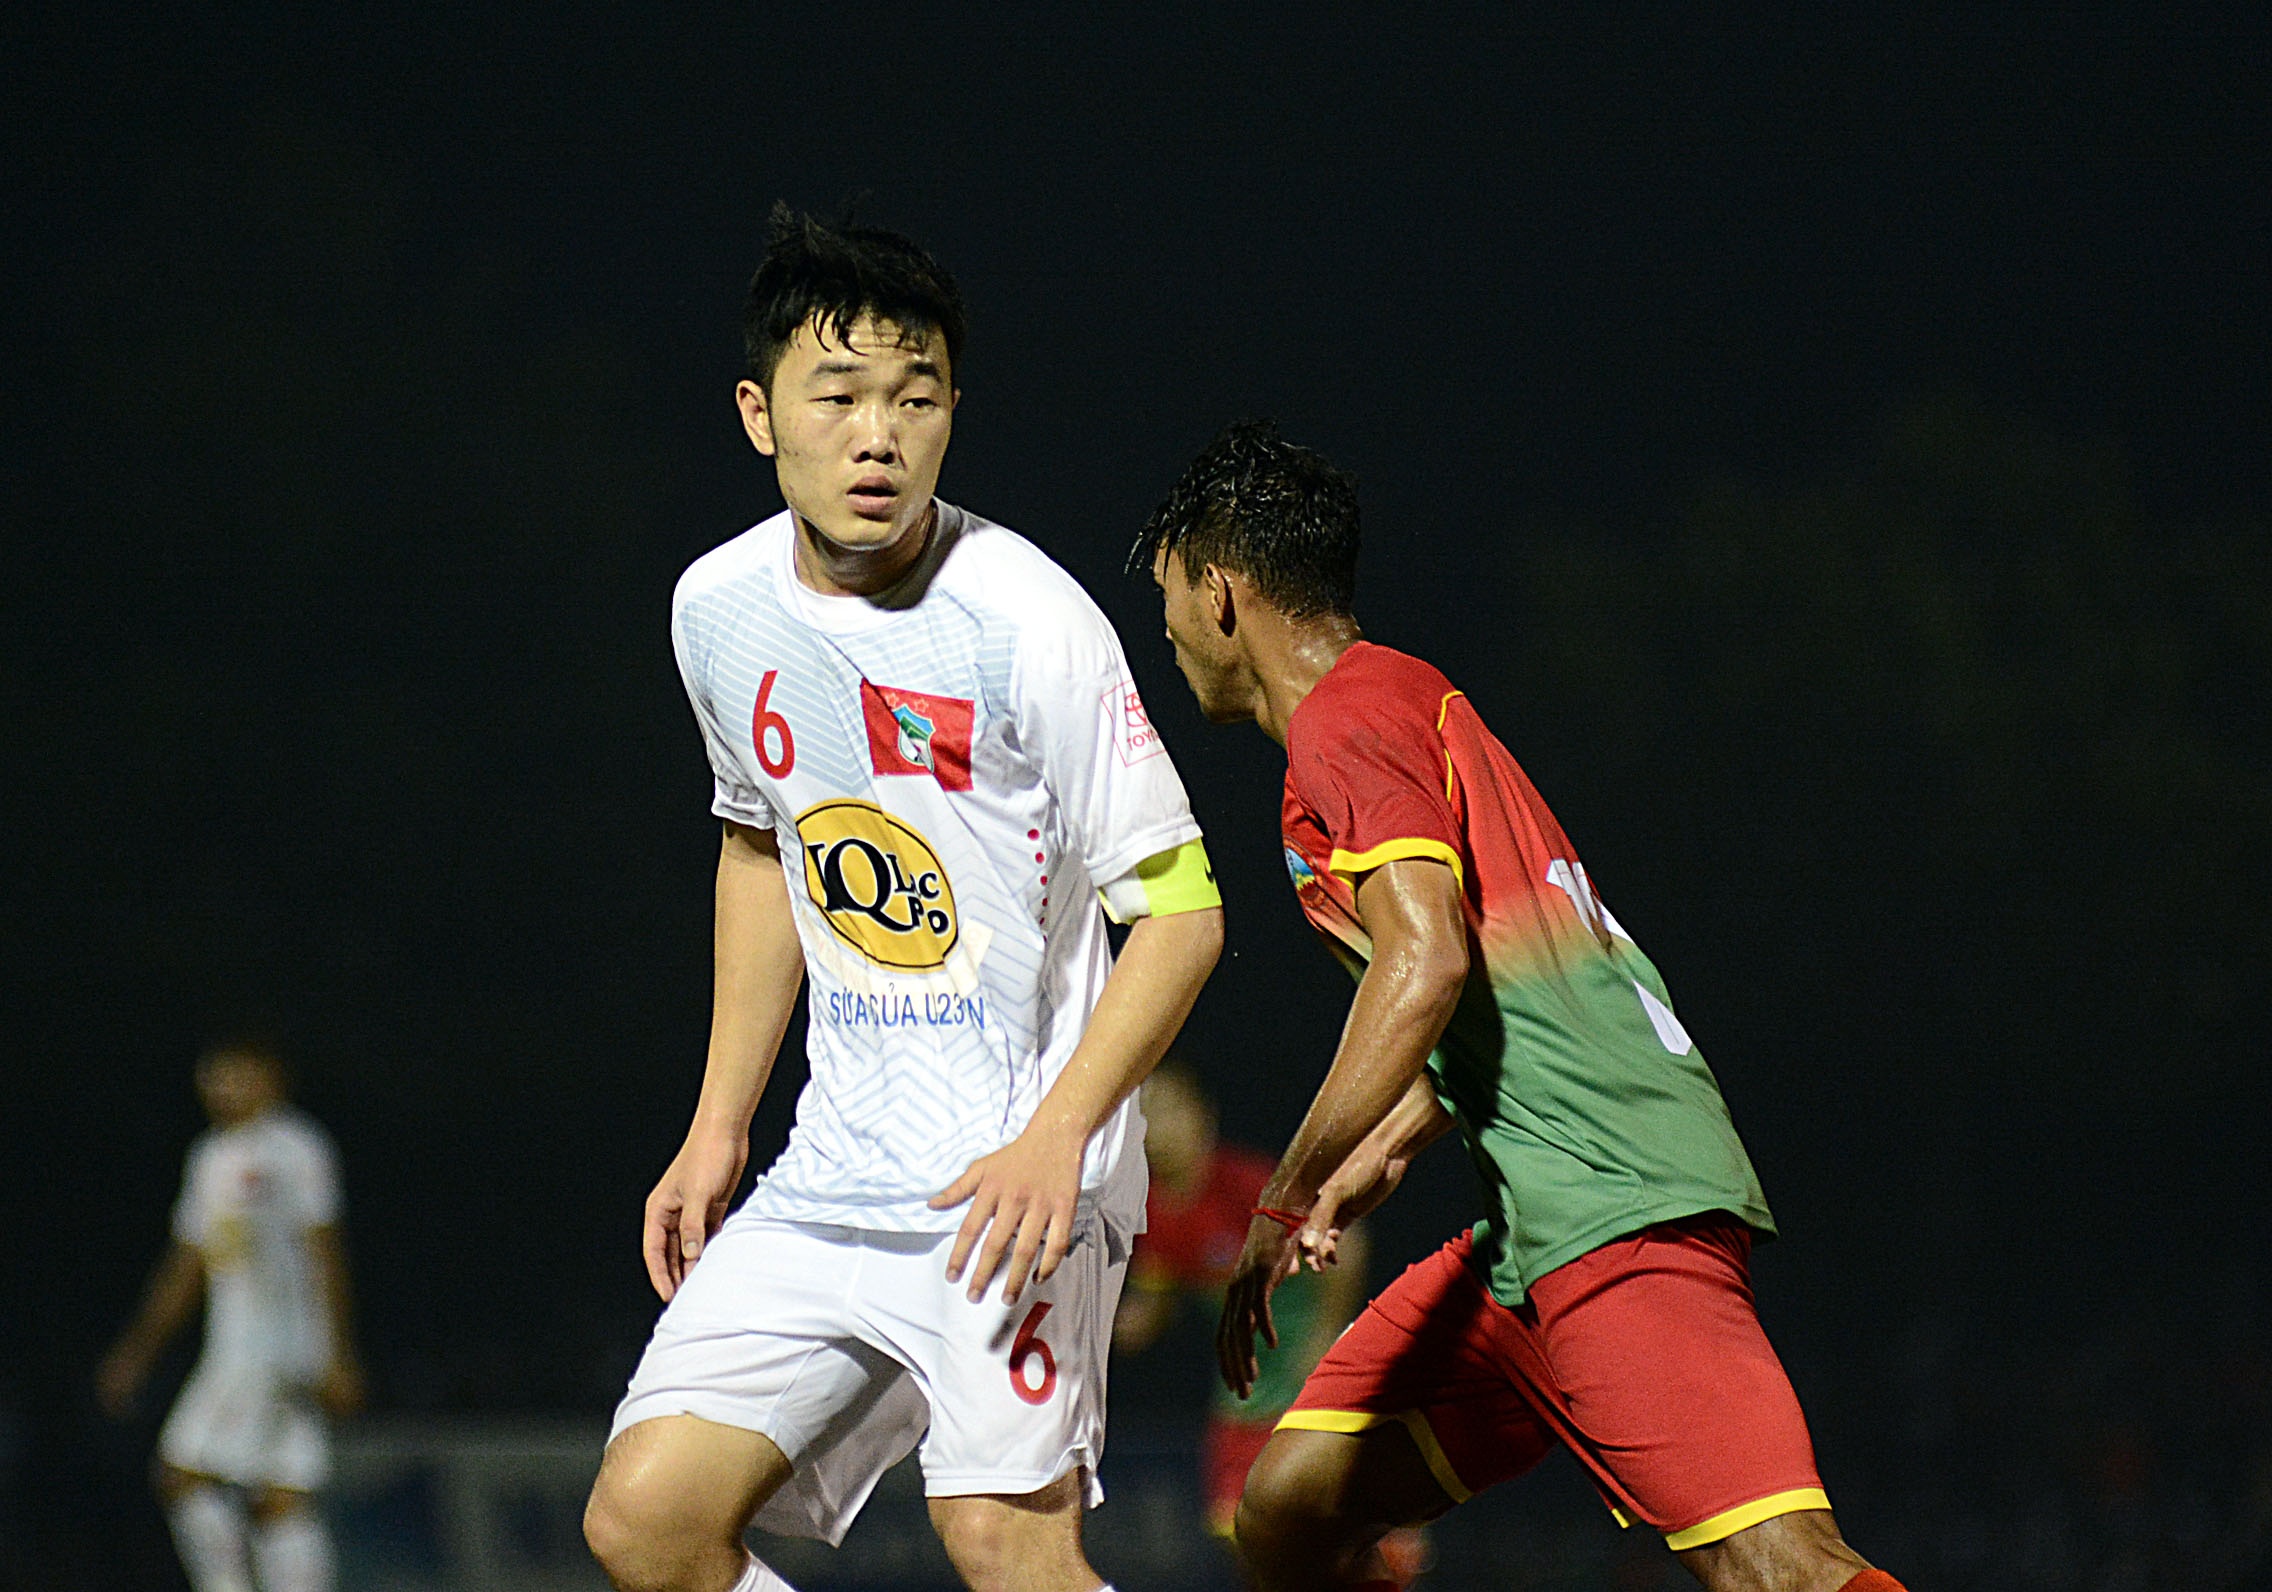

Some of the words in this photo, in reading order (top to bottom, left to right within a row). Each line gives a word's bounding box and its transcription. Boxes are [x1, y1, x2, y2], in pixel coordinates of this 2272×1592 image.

[752, 670, 795, 779] 6
[1127, 729, 1160, 751] TOY
[1009, 1300, 1057, 1406] 6
